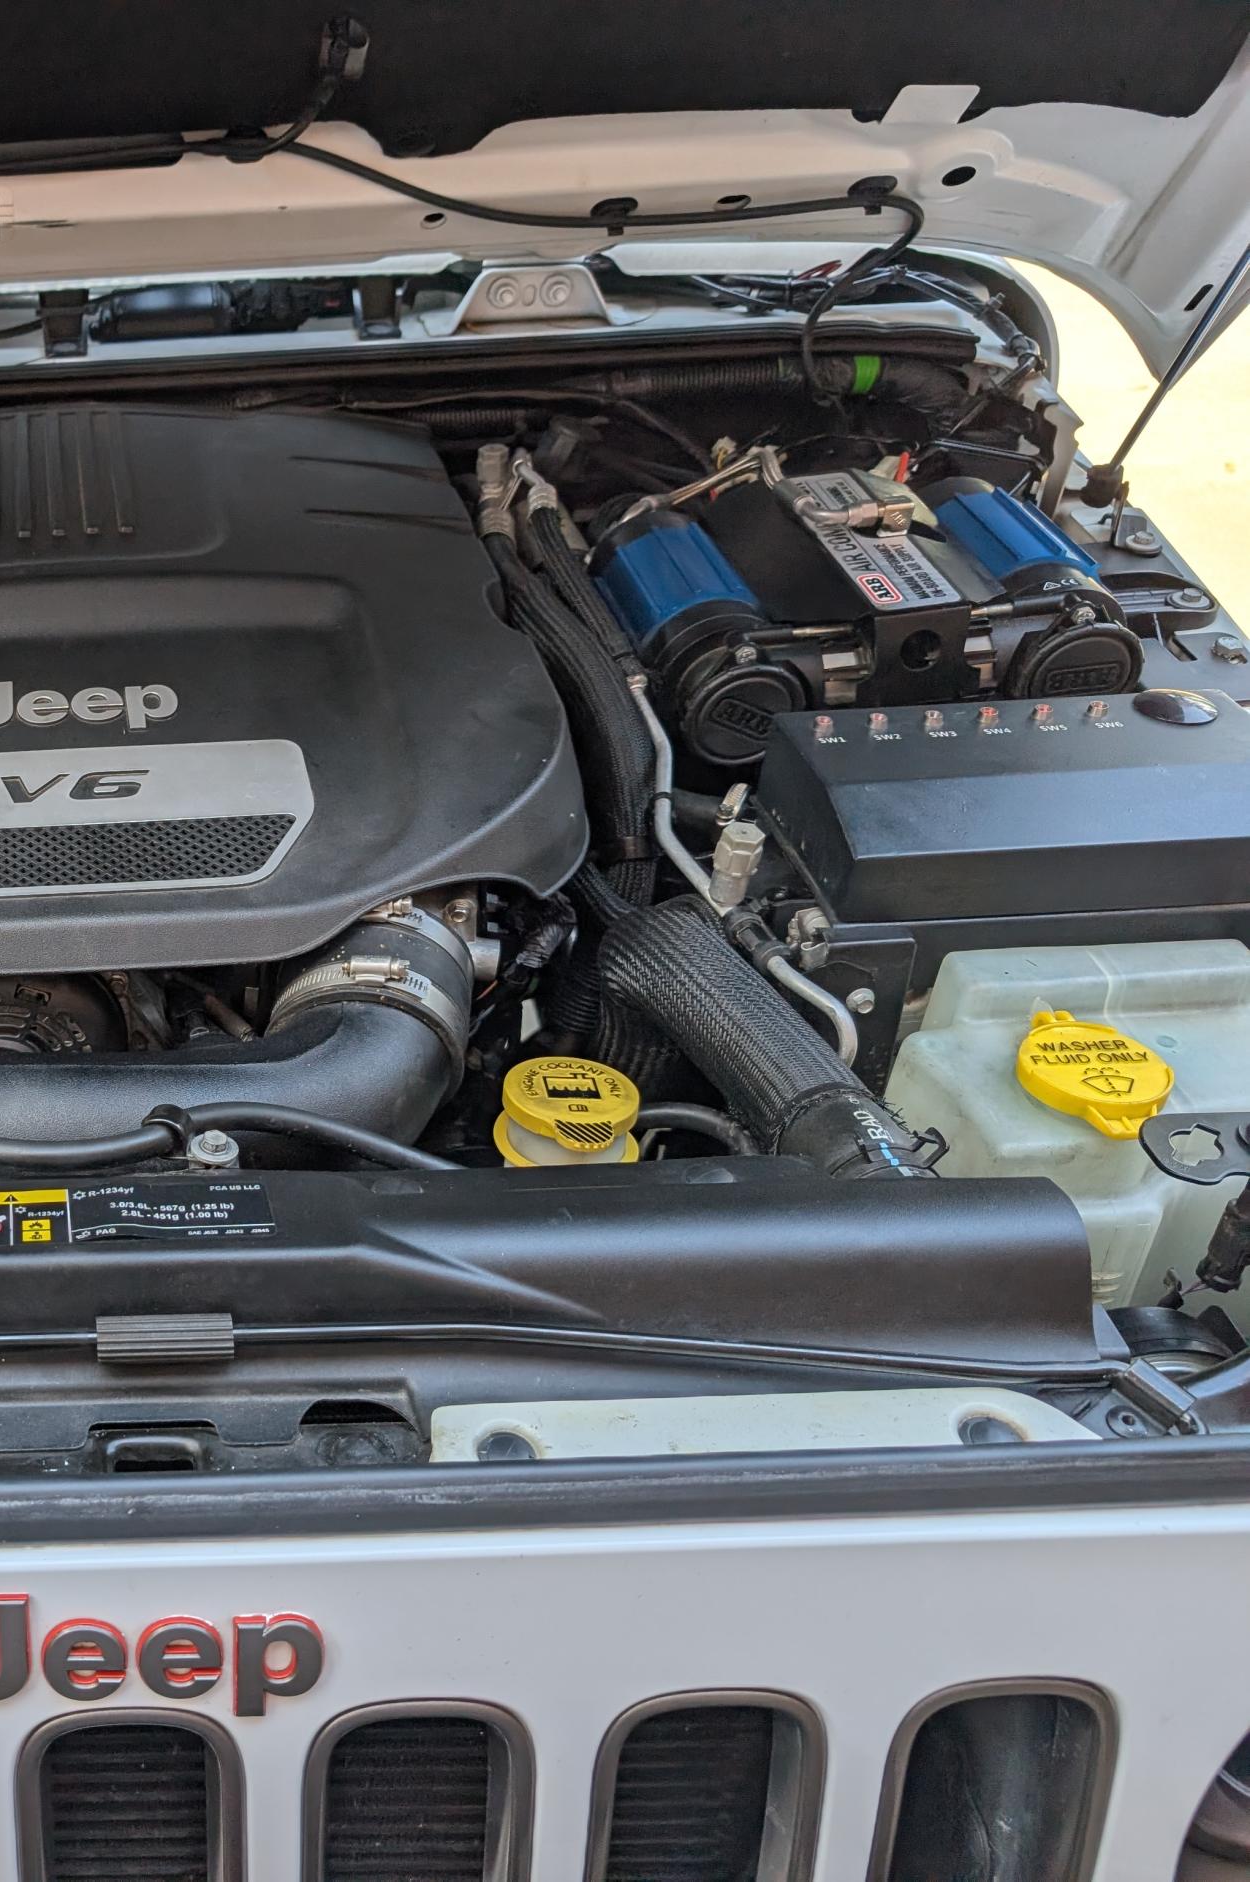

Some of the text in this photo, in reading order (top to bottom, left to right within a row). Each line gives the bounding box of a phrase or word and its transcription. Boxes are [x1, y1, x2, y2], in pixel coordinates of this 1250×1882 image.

[873, 544, 910, 579] PERFORMANCE
[890, 544, 915, 563] SUPPLY
[841, 553, 895, 599] ARB AIR
[916, 571, 947, 597] ON-BOARD
[818, 736, 847, 744] SW1
[929, 730, 958, 738] SW3
[983, 727, 1012, 735] SW4
[1095, 721, 1124, 729] SW6
[1, 769, 150, 804] V6
[1036, 1039, 1129, 1052] WASHER
[1030, 1051, 1149, 1065] FLUID ONLY
[523, 1062, 622, 1098] ENGINE COOLANT ONLY
[853, 1109, 888, 1141] RAD
[88, 1186, 134, 1198] R-1234yf
[110, 1202, 150, 1210] 3.0/3.6L
[191, 1203, 217, 1211] (1.25
[219, 1202, 235, 1210] lb)
[121, 1210, 145, 1218] 2.8L
[153, 1212, 180, 1220] 451g
[184, 1211, 211, 1220] (1.00
[213, 1211, 228, 1219] lb)
